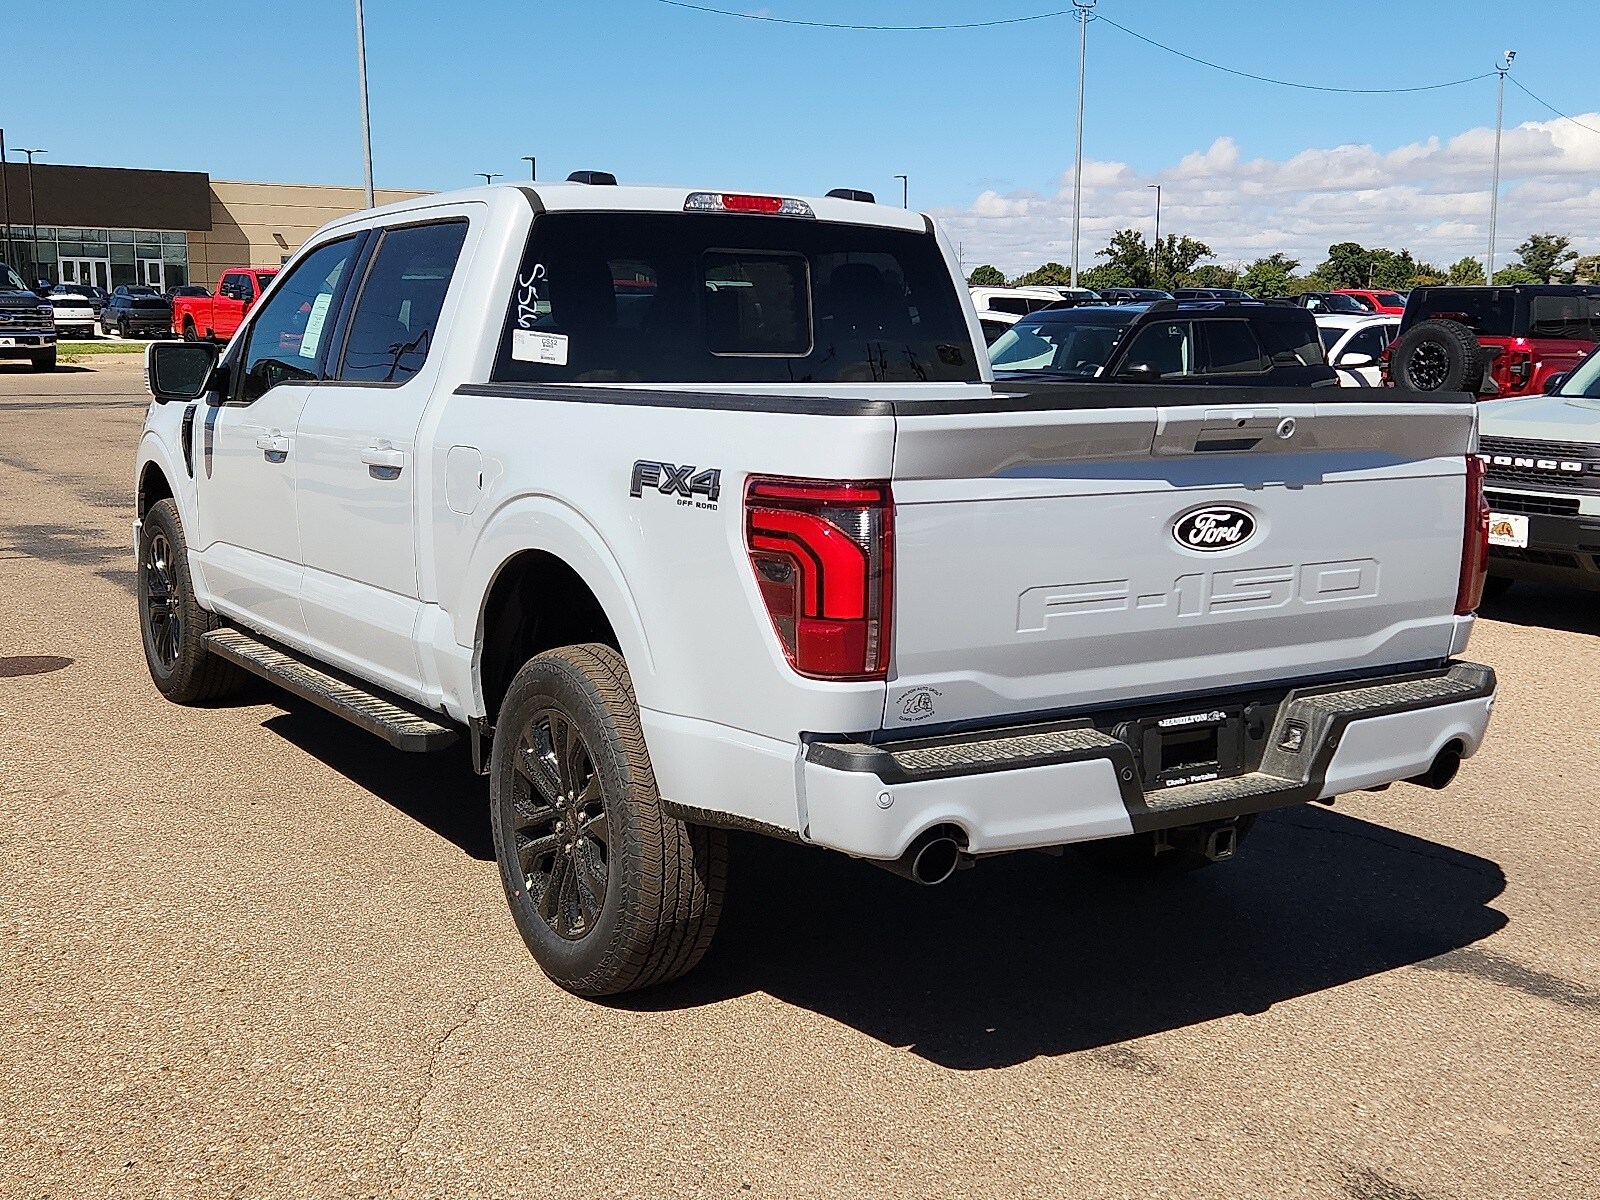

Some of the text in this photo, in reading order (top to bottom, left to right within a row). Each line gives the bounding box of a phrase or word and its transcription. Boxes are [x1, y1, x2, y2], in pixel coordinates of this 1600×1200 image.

[629, 459, 722, 502] FX4
[676, 498, 718, 511] OFF ROAD
[1188, 513, 1244, 544] Ford
[1015, 557, 1381, 634] F-150
